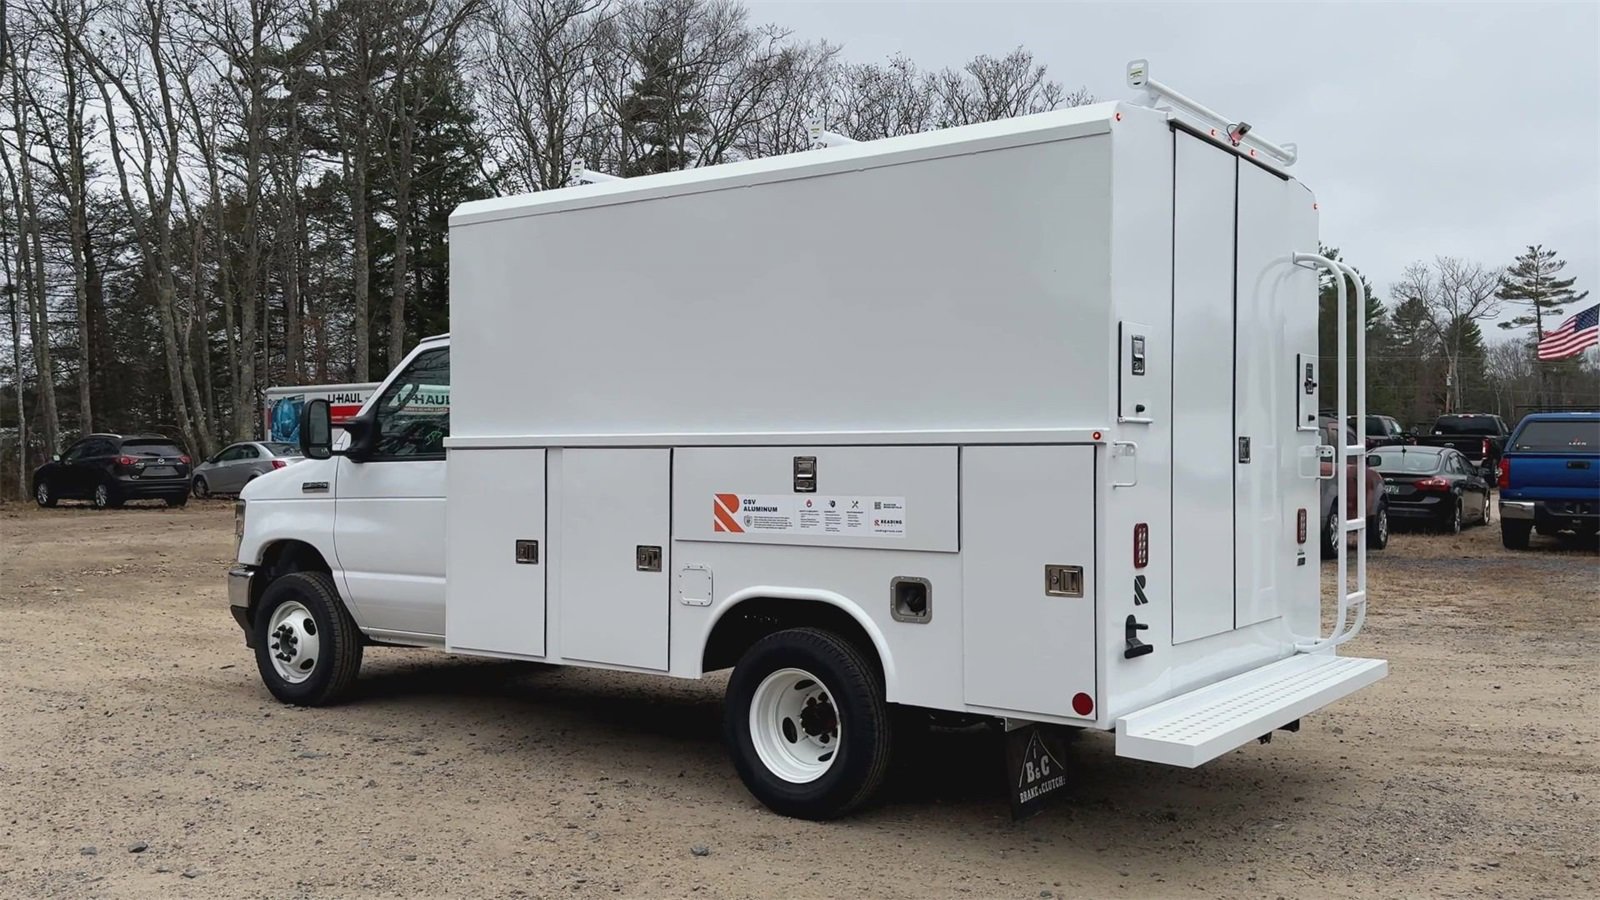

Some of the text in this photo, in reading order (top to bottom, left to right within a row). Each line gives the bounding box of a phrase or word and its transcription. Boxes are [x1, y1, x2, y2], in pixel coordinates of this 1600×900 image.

[327, 393, 363, 404] U-HAUL
[743, 505, 778, 513] ALUMINUM
[1020, 786, 1039, 803] BRAKE
